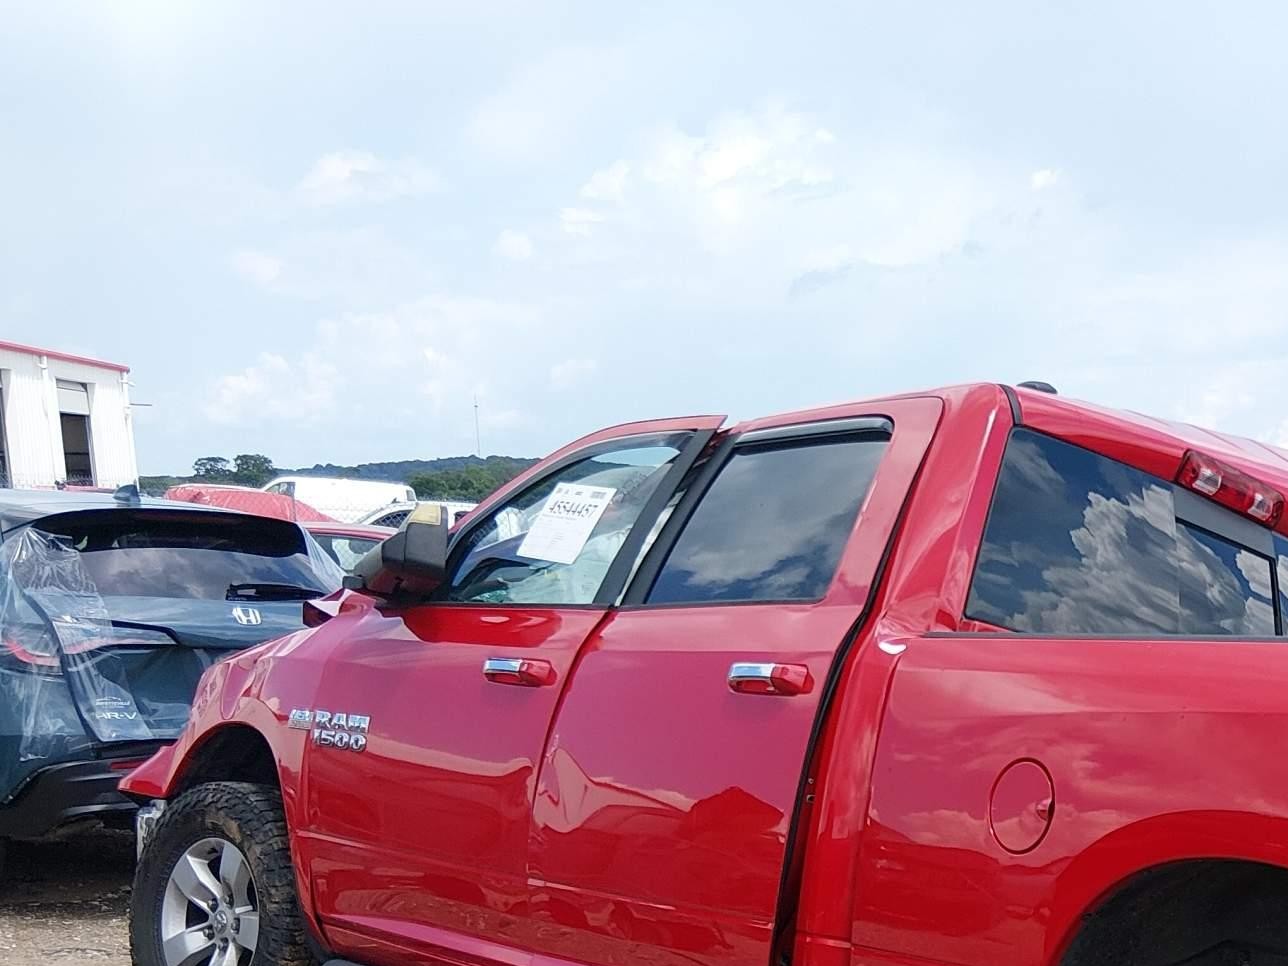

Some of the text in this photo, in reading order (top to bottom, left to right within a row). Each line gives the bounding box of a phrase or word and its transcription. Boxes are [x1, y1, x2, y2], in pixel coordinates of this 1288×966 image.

[548, 501, 600, 518] 45544457
[314, 709, 371, 732] RAM
[312, 729, 367, 752] 1500
